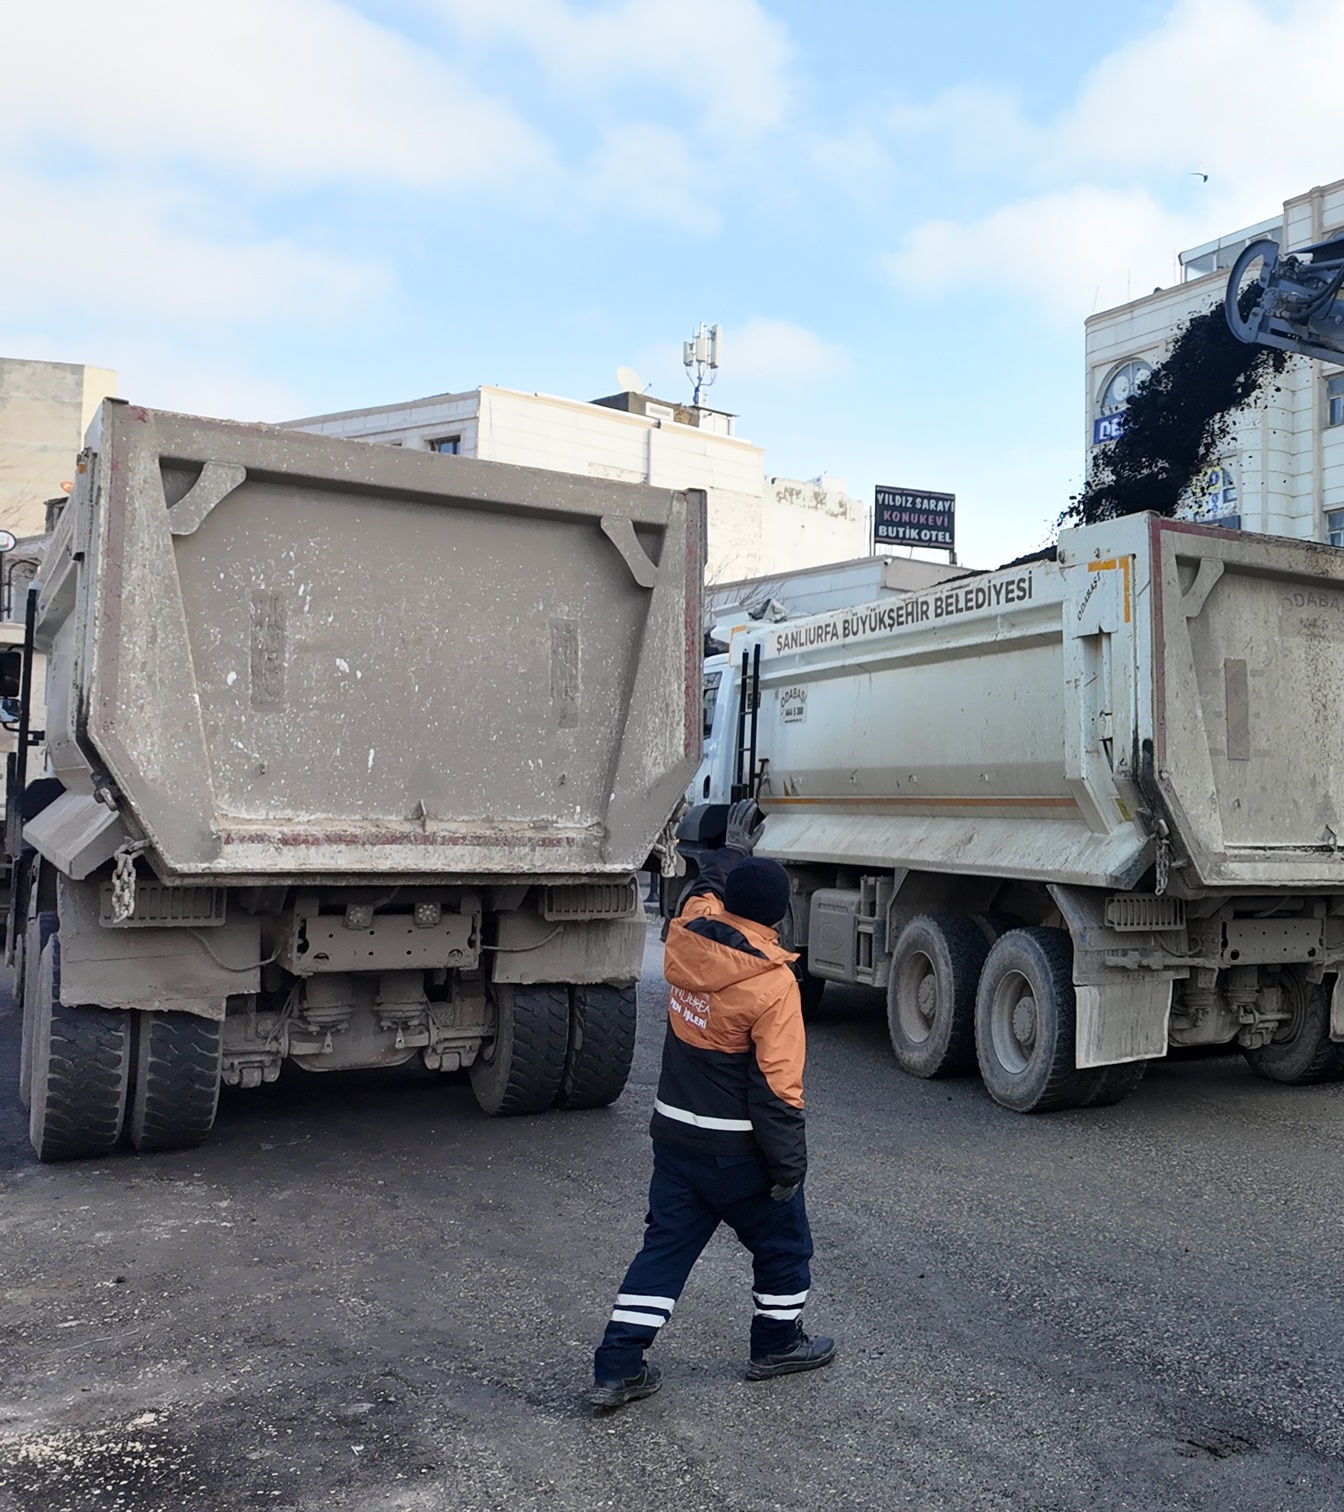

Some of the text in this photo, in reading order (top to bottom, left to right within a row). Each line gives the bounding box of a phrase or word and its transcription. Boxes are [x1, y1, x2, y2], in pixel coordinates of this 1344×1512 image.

[877, 493, 954, 512] YILDIZ SARAYI
[883, 510, 949, 527] KONUKEVİ
[879, 525, 952, 543] BUTİK OTEL
[776, 570, 1033, 655] ŞANLIURFA BÜYÜKŞEHİR BELEDİYESİ
